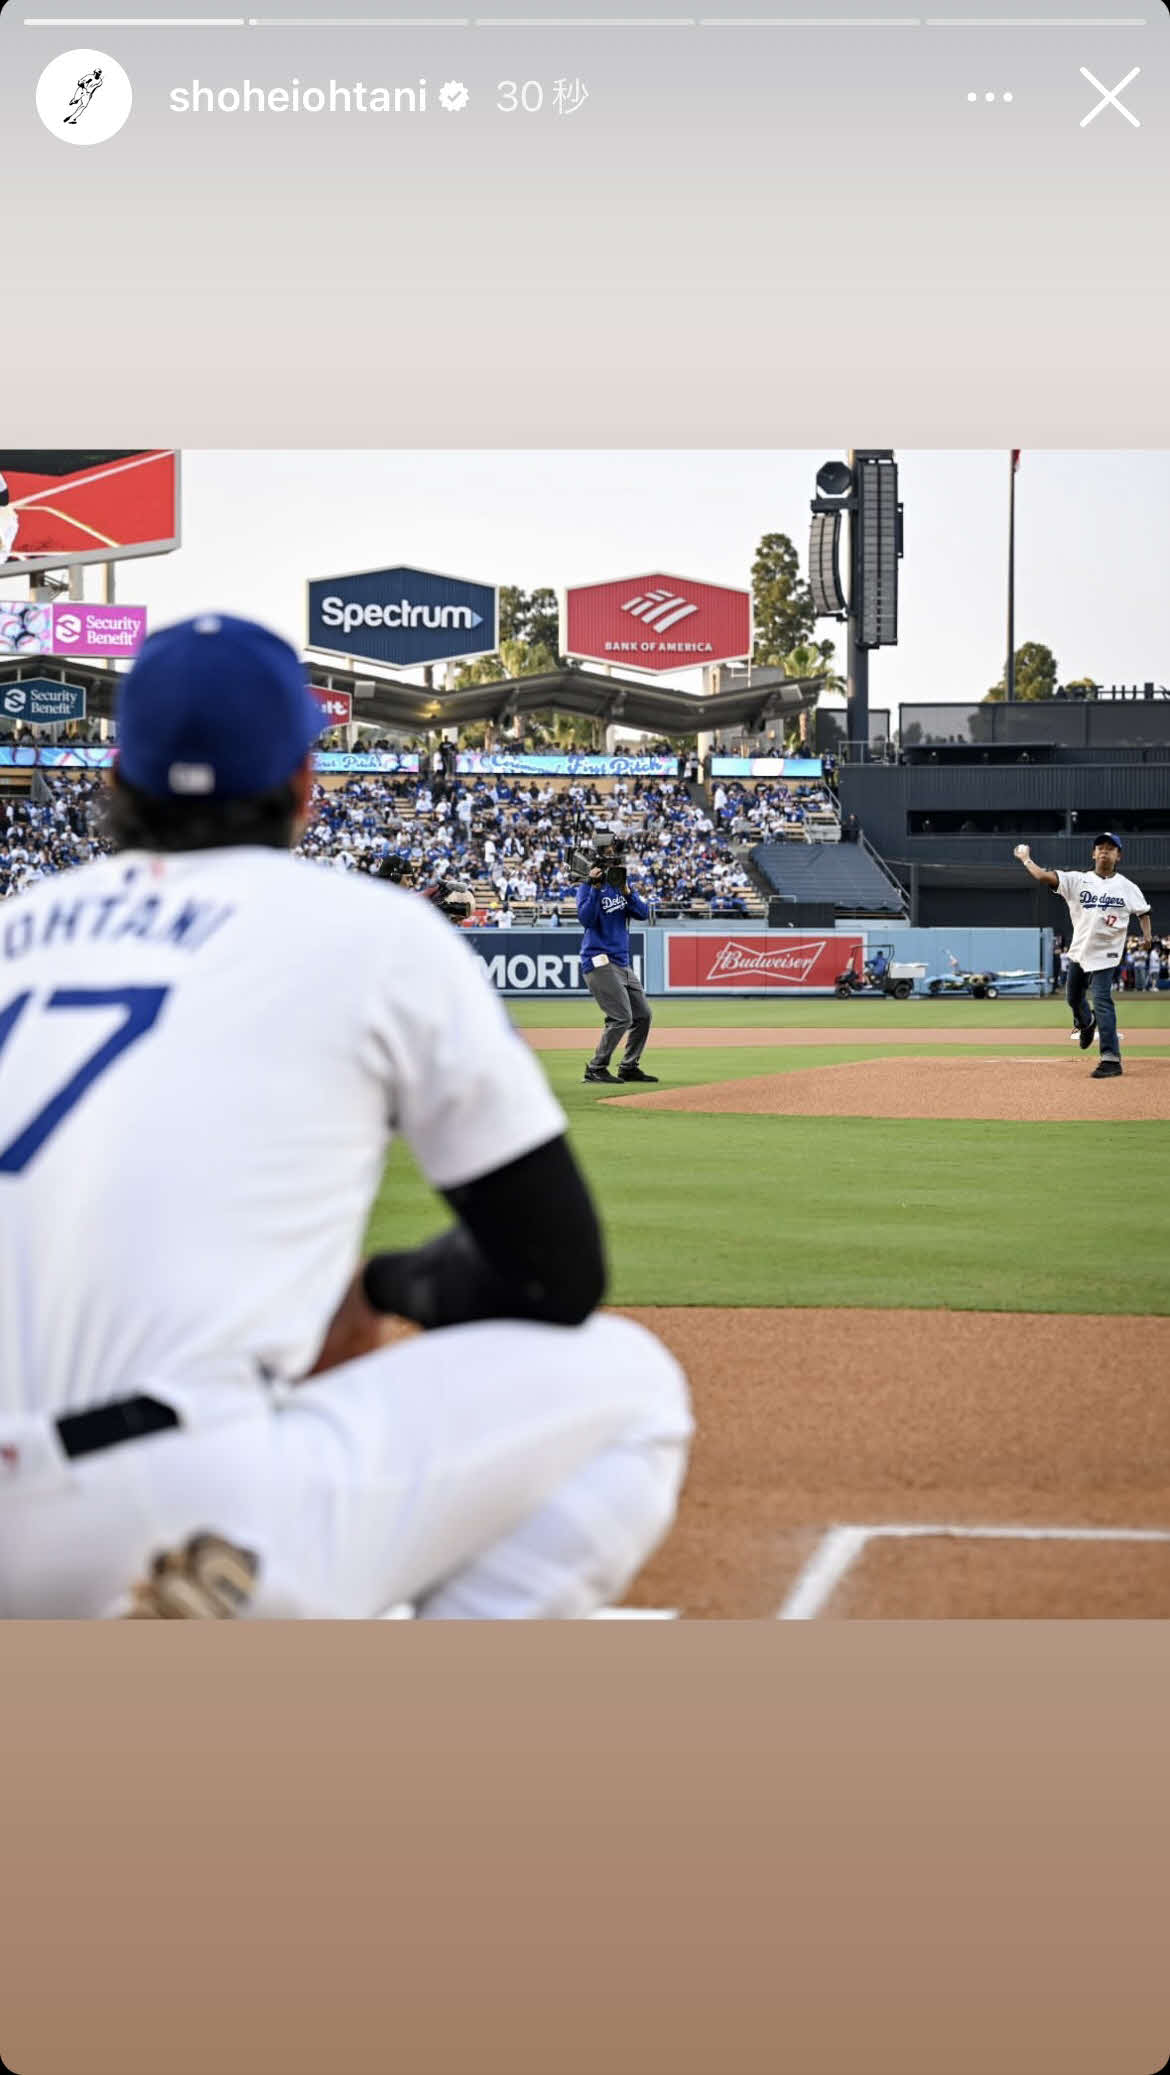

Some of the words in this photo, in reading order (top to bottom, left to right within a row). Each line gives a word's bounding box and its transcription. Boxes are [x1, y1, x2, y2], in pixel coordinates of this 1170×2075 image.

[321, 596, 472, 633] Spectrum
[86, 614, 140, 637] Security
[87, 630, 132, 645] Benefit
[604, 641, 638, 652] BANK
[640, 641, 656, 652] OF
[658, 641, 713, 653] AMERICA
[30, 689, 77, 704] Security
[31, 702, 71, 714] Benefit
[609, 756, 663, 774] Pitch
[1080, 890, 1126, 911] Dodgers
[716, 951, 813, 971] Budweiser
